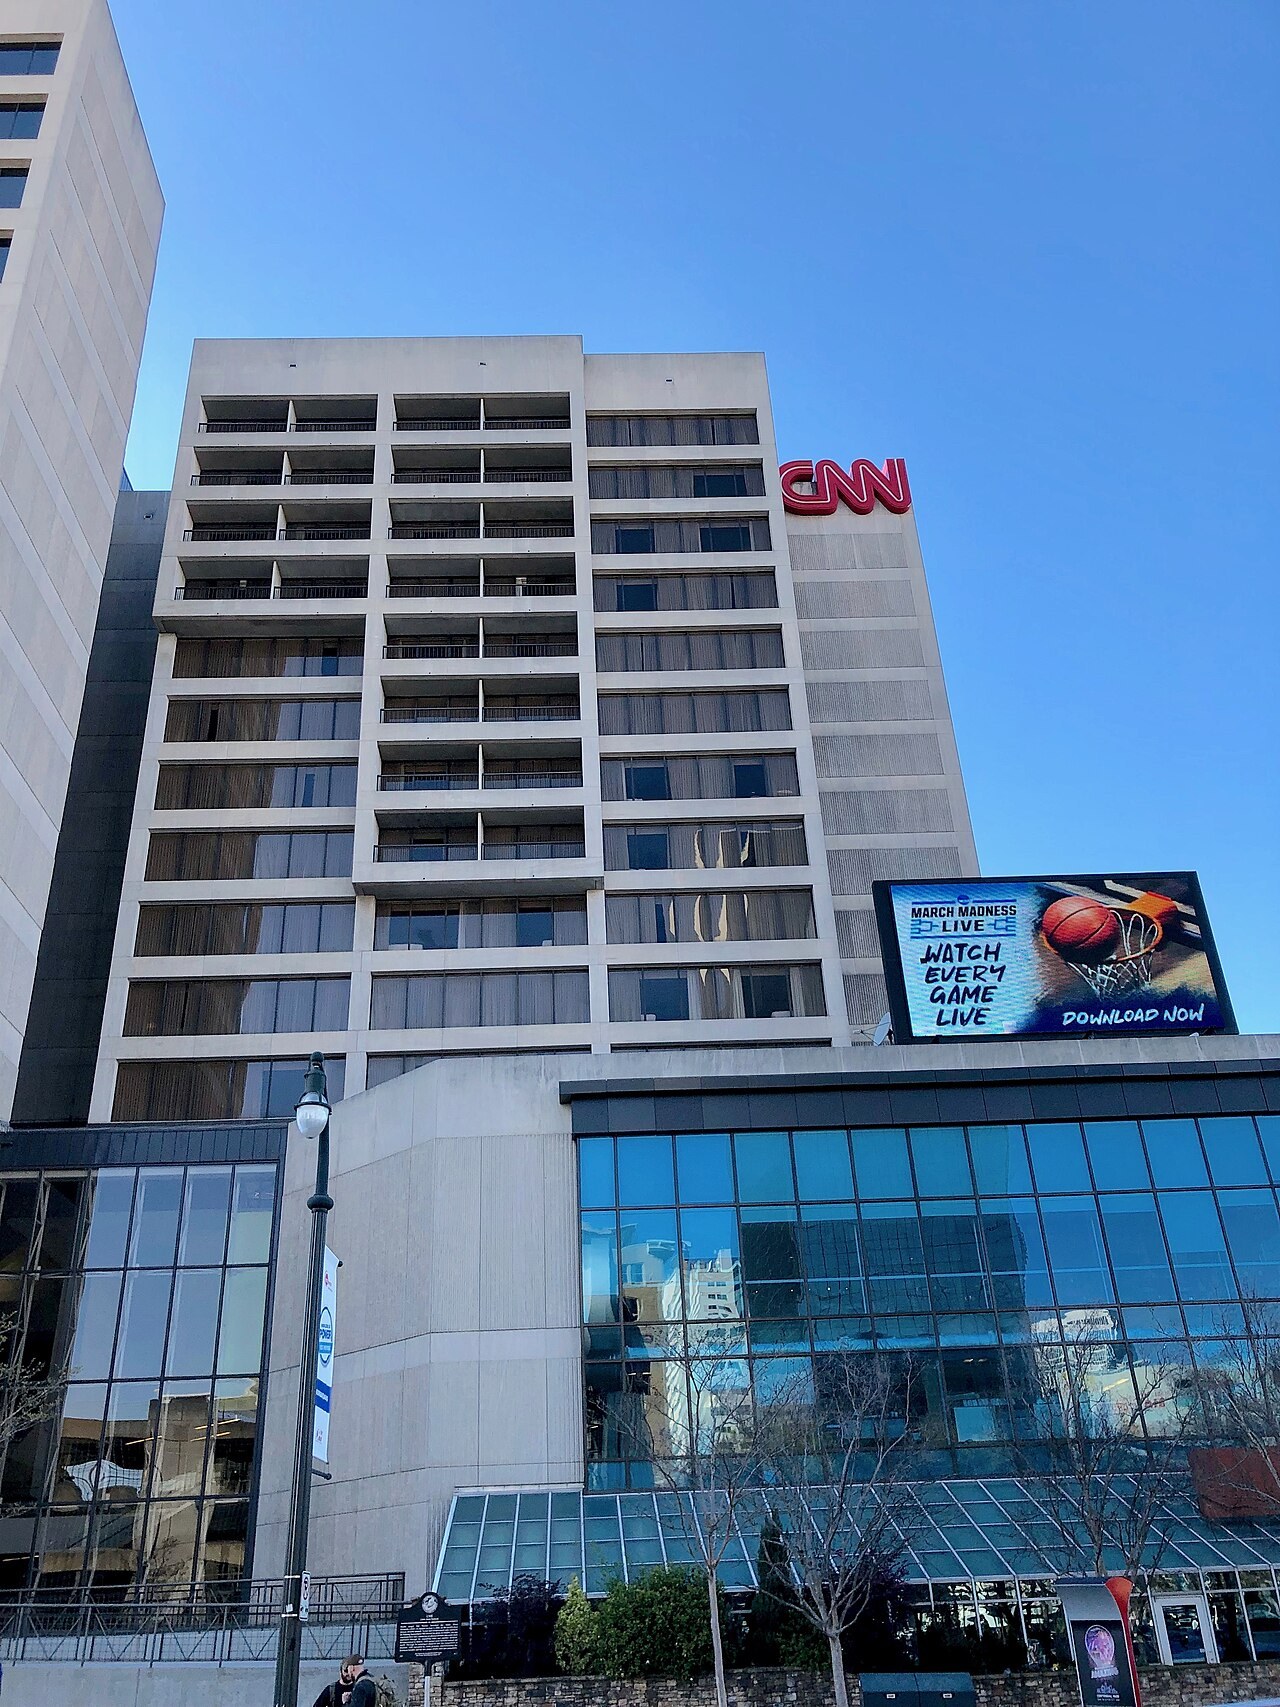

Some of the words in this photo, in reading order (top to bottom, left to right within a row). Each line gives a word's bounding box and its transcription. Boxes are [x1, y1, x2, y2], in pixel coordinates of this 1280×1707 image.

[778, 457, 912, 516] CNN
[911, 907, 954, 918] MARCH
[958, 905, 1017, 917] MADNESS
[942, 919, 985, 932] LIVE
[920, 942, 1002, 964] WATCH
[925, 964, 1006, 984] EVERY
[929, 984, 998, 1005] GAME
[936, 1007, 991, 1026] LIVE
[1062, 1008, 1159, 1026] DOWNLOAD
[1163, 1003, 1204, 1023] NOW
